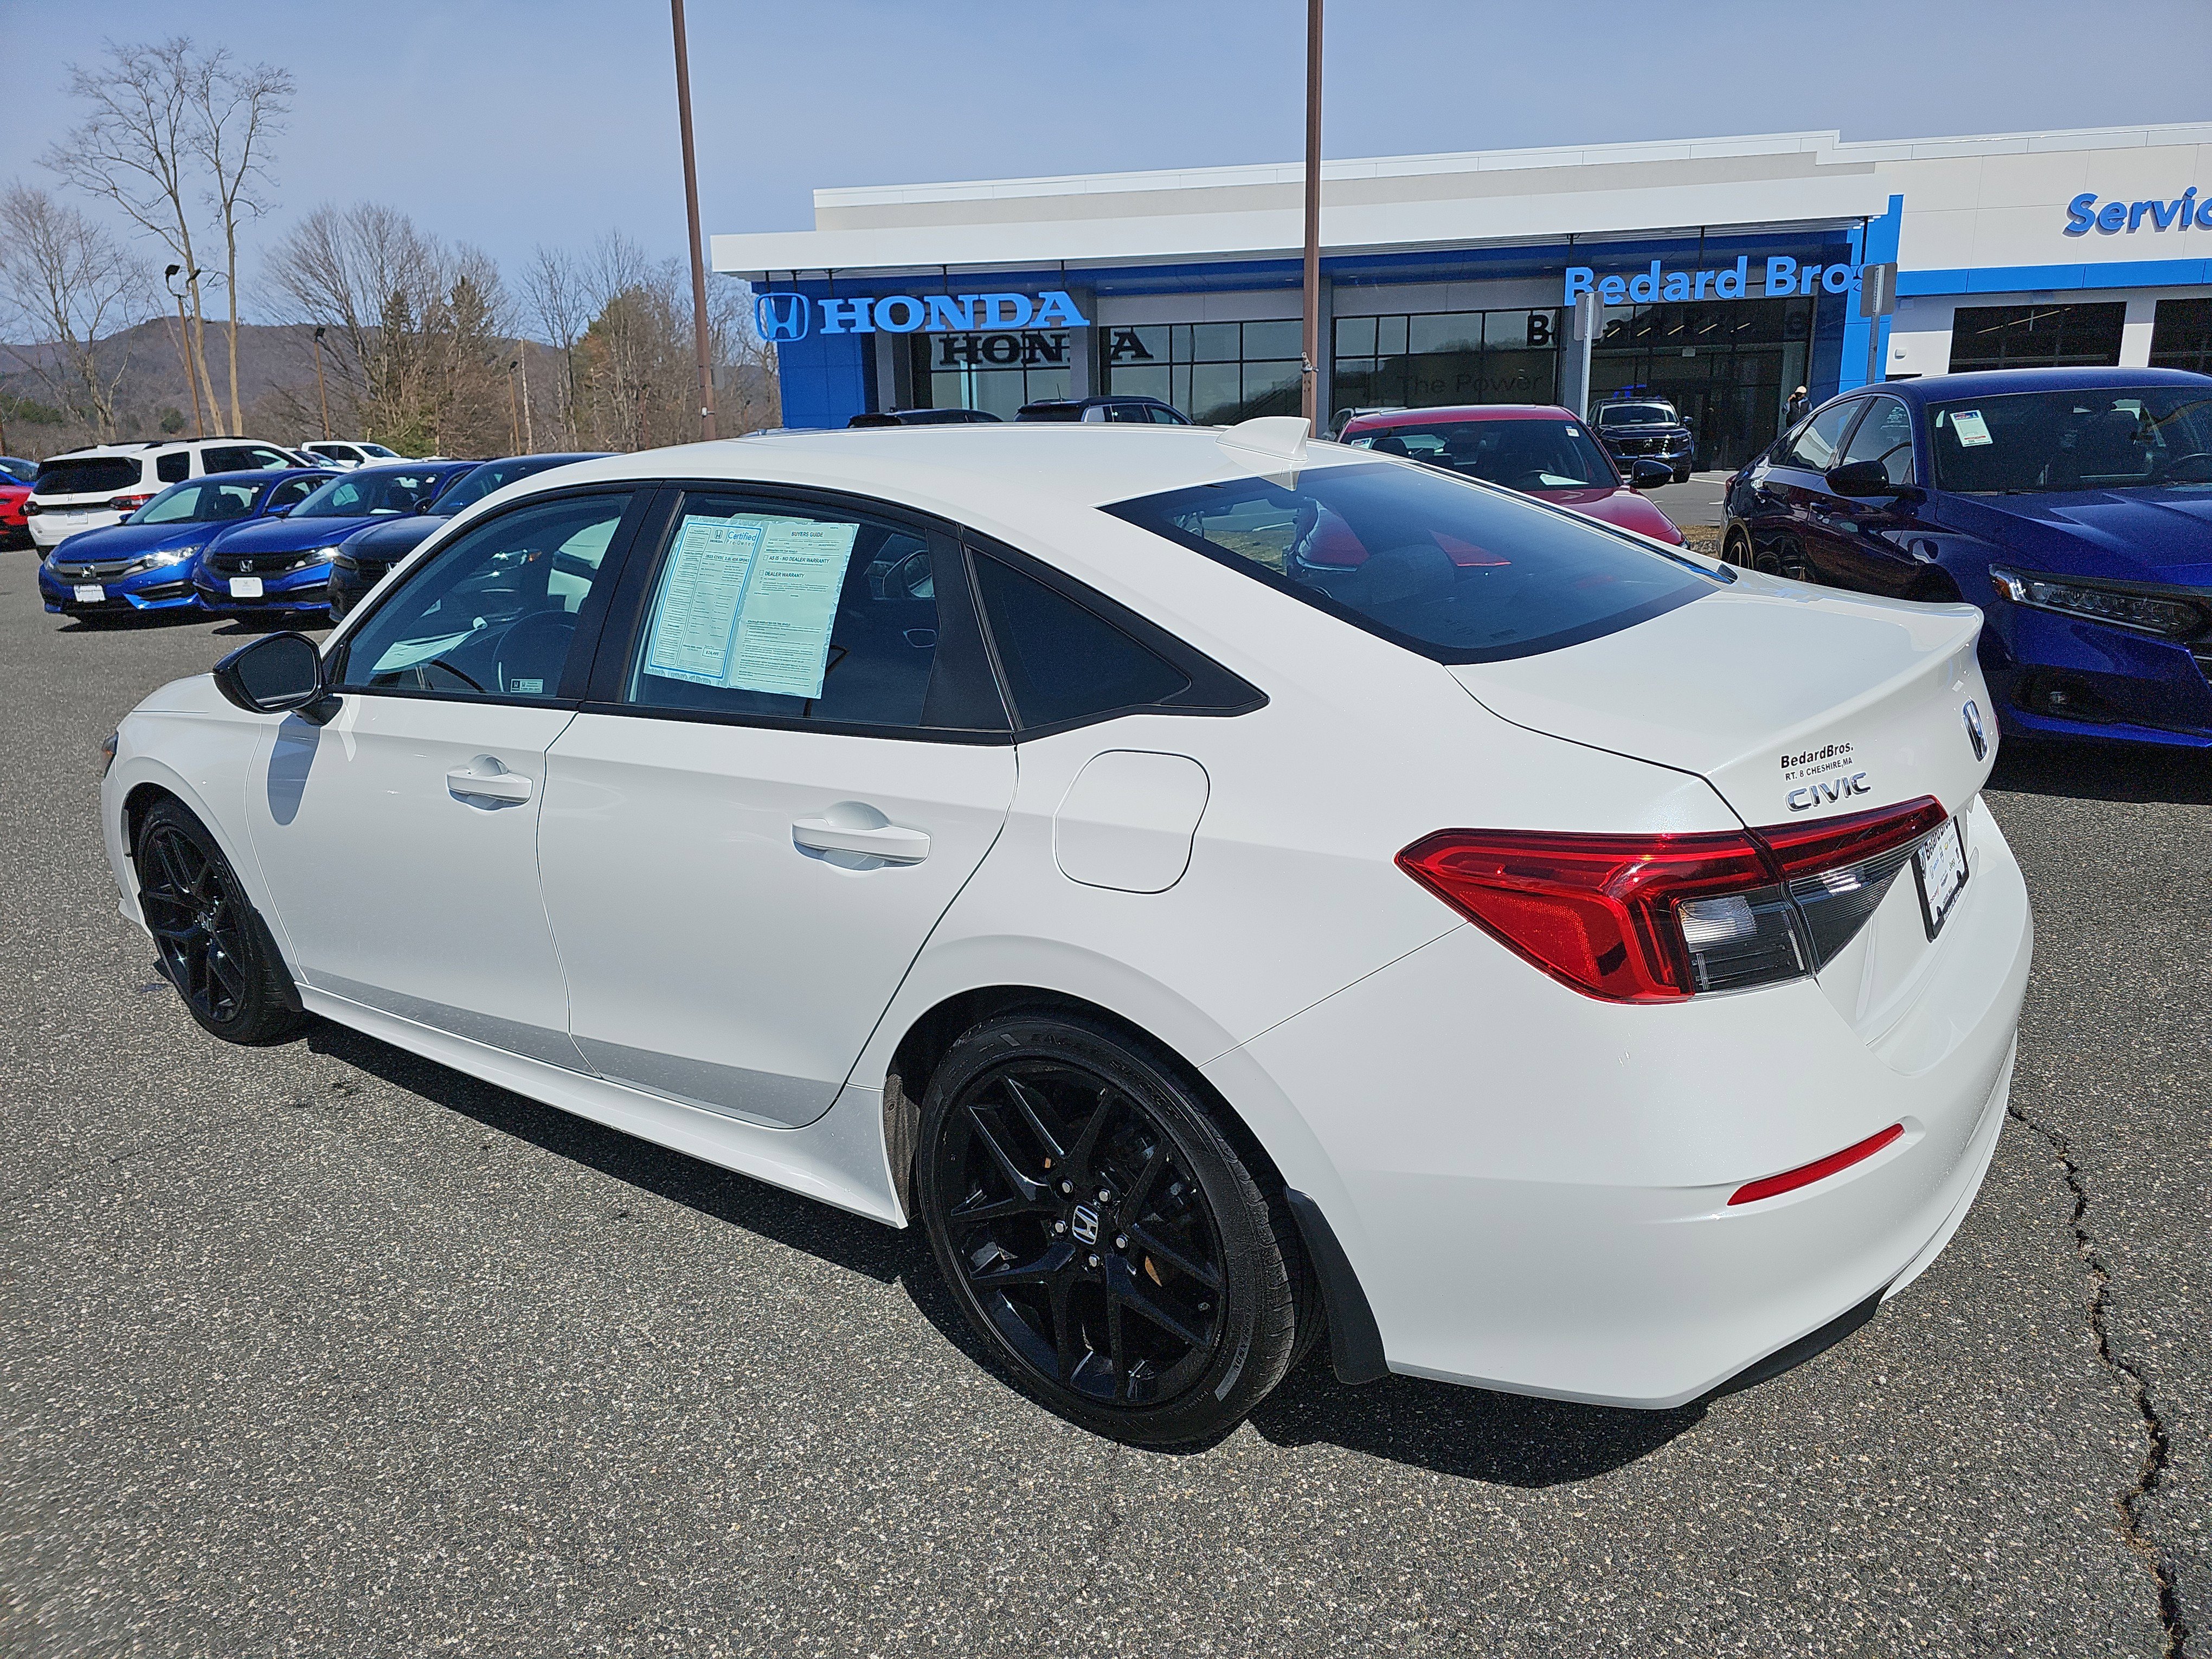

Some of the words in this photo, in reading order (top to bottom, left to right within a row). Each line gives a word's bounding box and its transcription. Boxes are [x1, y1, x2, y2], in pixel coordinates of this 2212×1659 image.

[1564, 255, 1748, 306] Bedard
[818, 291, 1090, 335] HONDA
[939, 331, 1154, 366] HONA
[728, 531, 758, 541] Certified
[1781, 742, 1854, 769] BedardBros.
[1785, 771, 1798, 781] RT.
[1786, 772, 1871, 812] CIVIC
